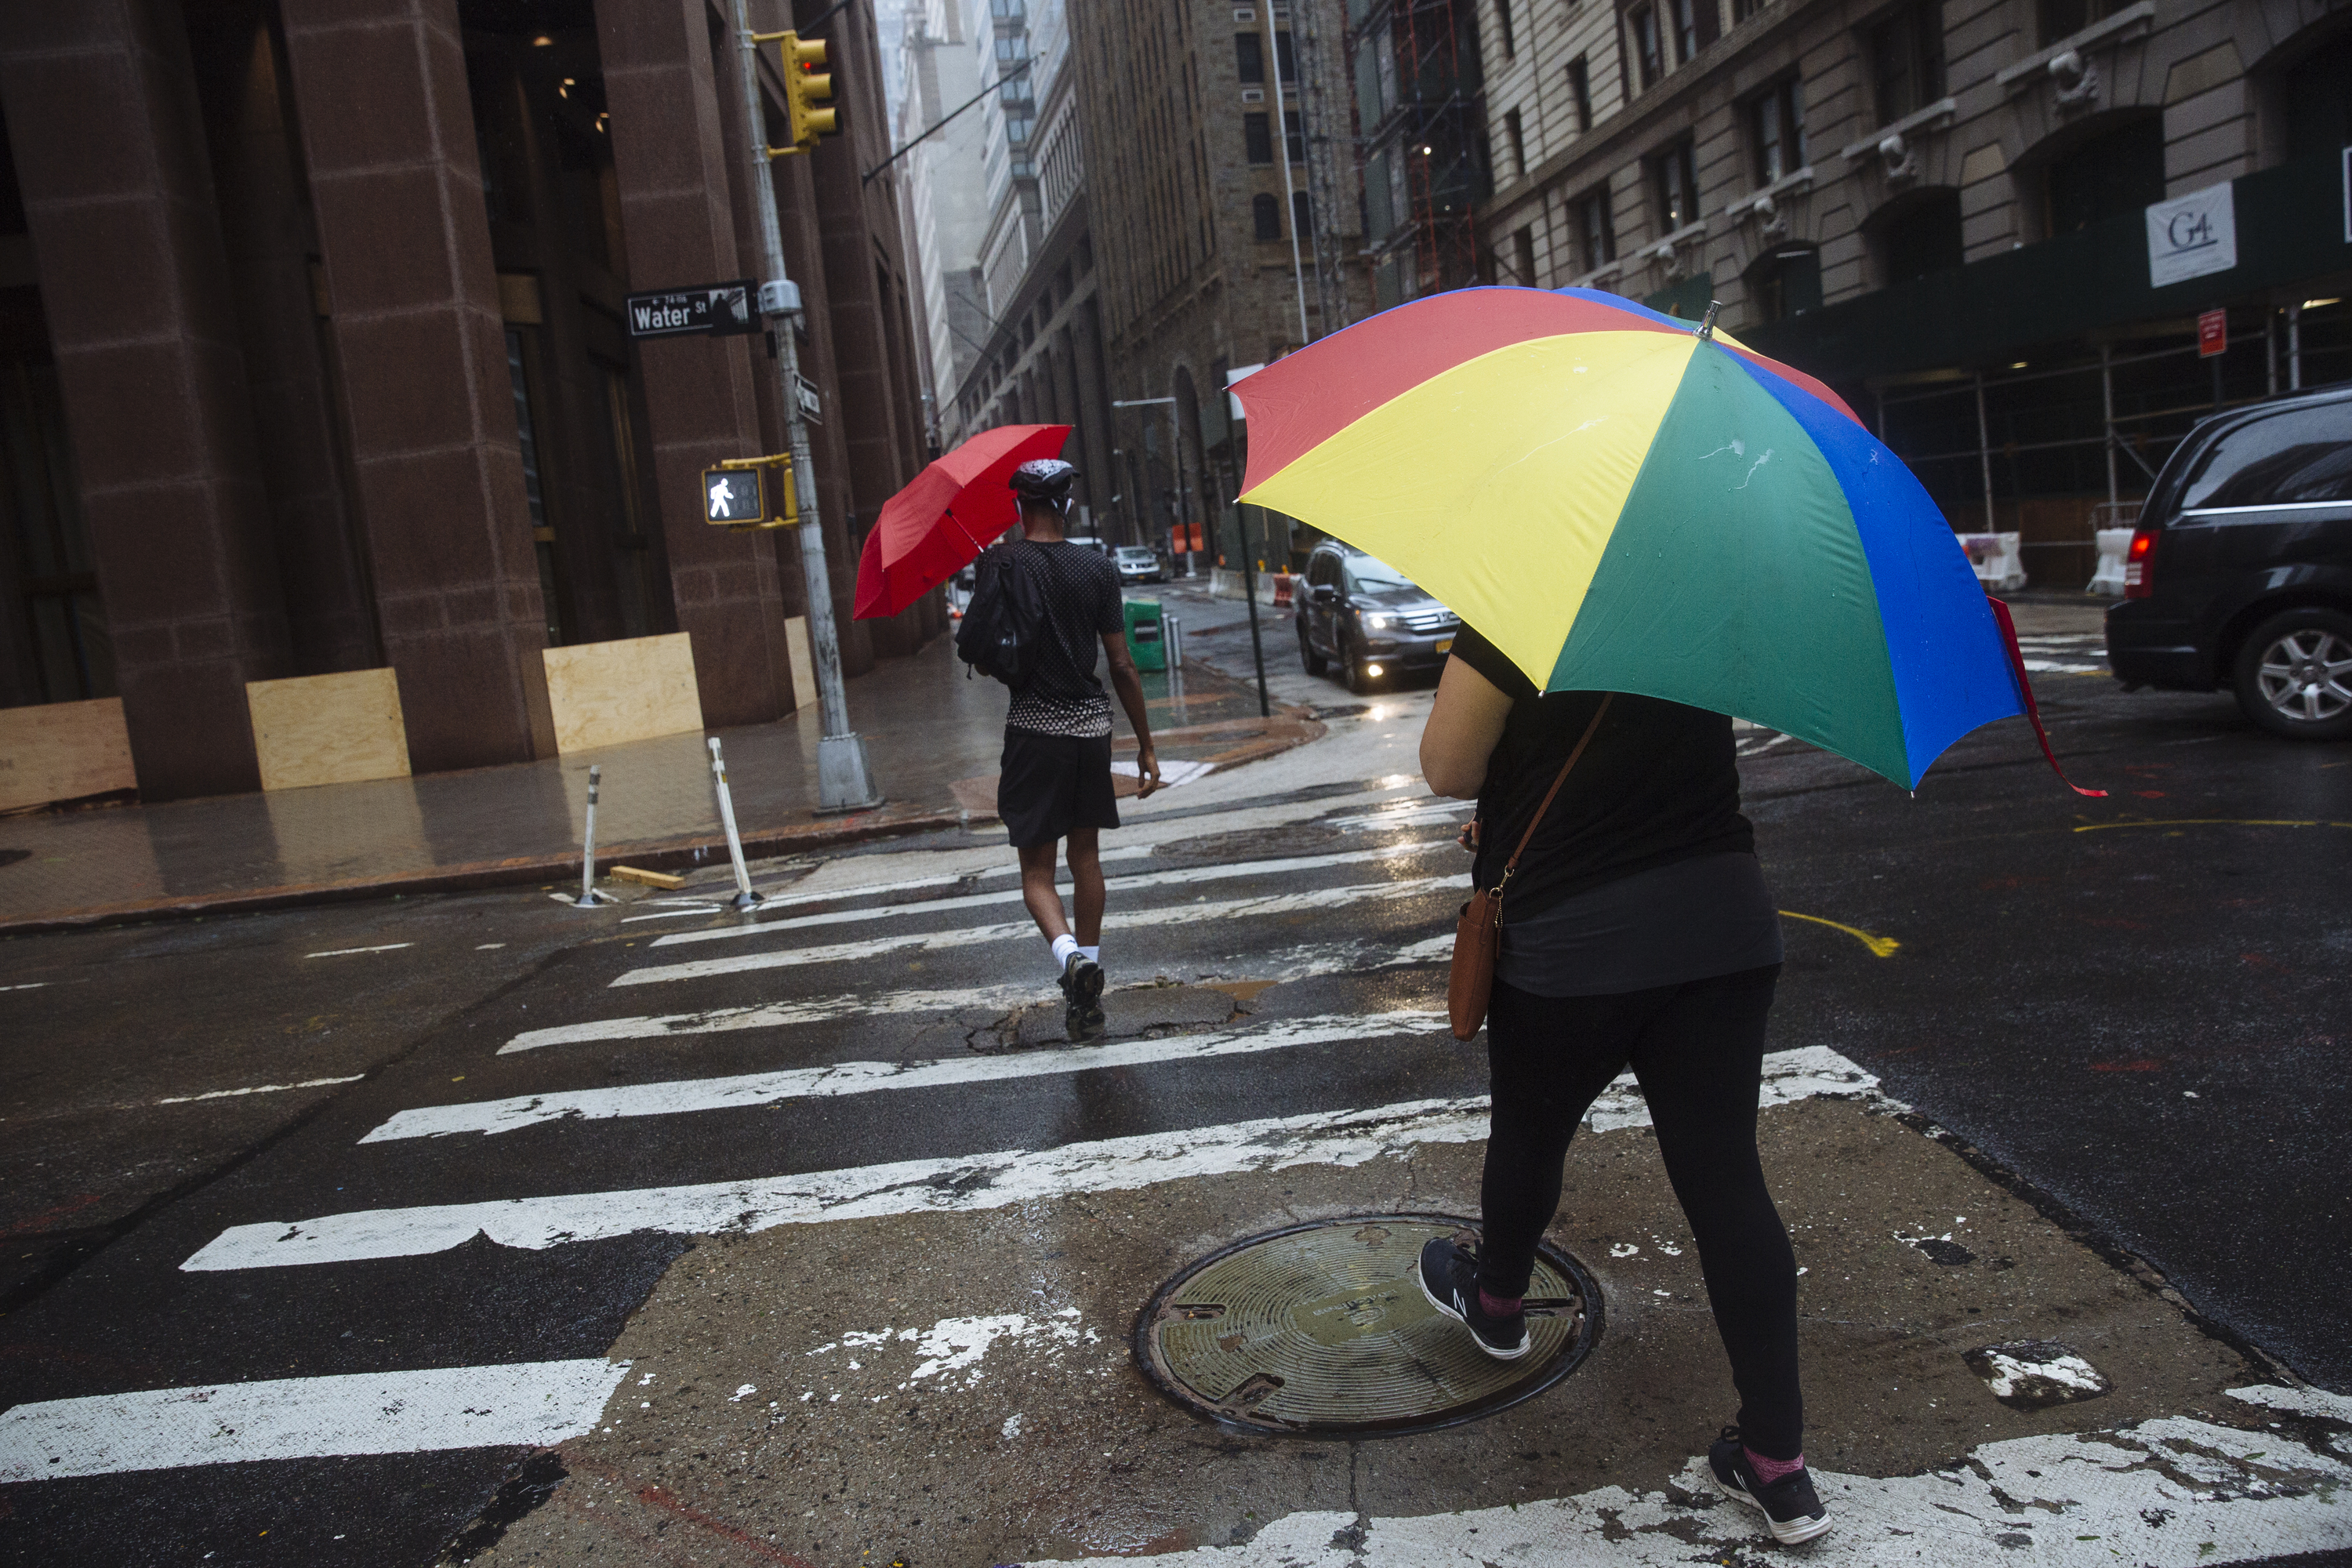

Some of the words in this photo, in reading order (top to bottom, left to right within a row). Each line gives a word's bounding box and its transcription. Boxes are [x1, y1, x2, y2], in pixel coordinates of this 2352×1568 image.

[2168, 212, 2212, 249] G4
[634, 305, 691, 330] Water
[695, 301, 707, 314] St
